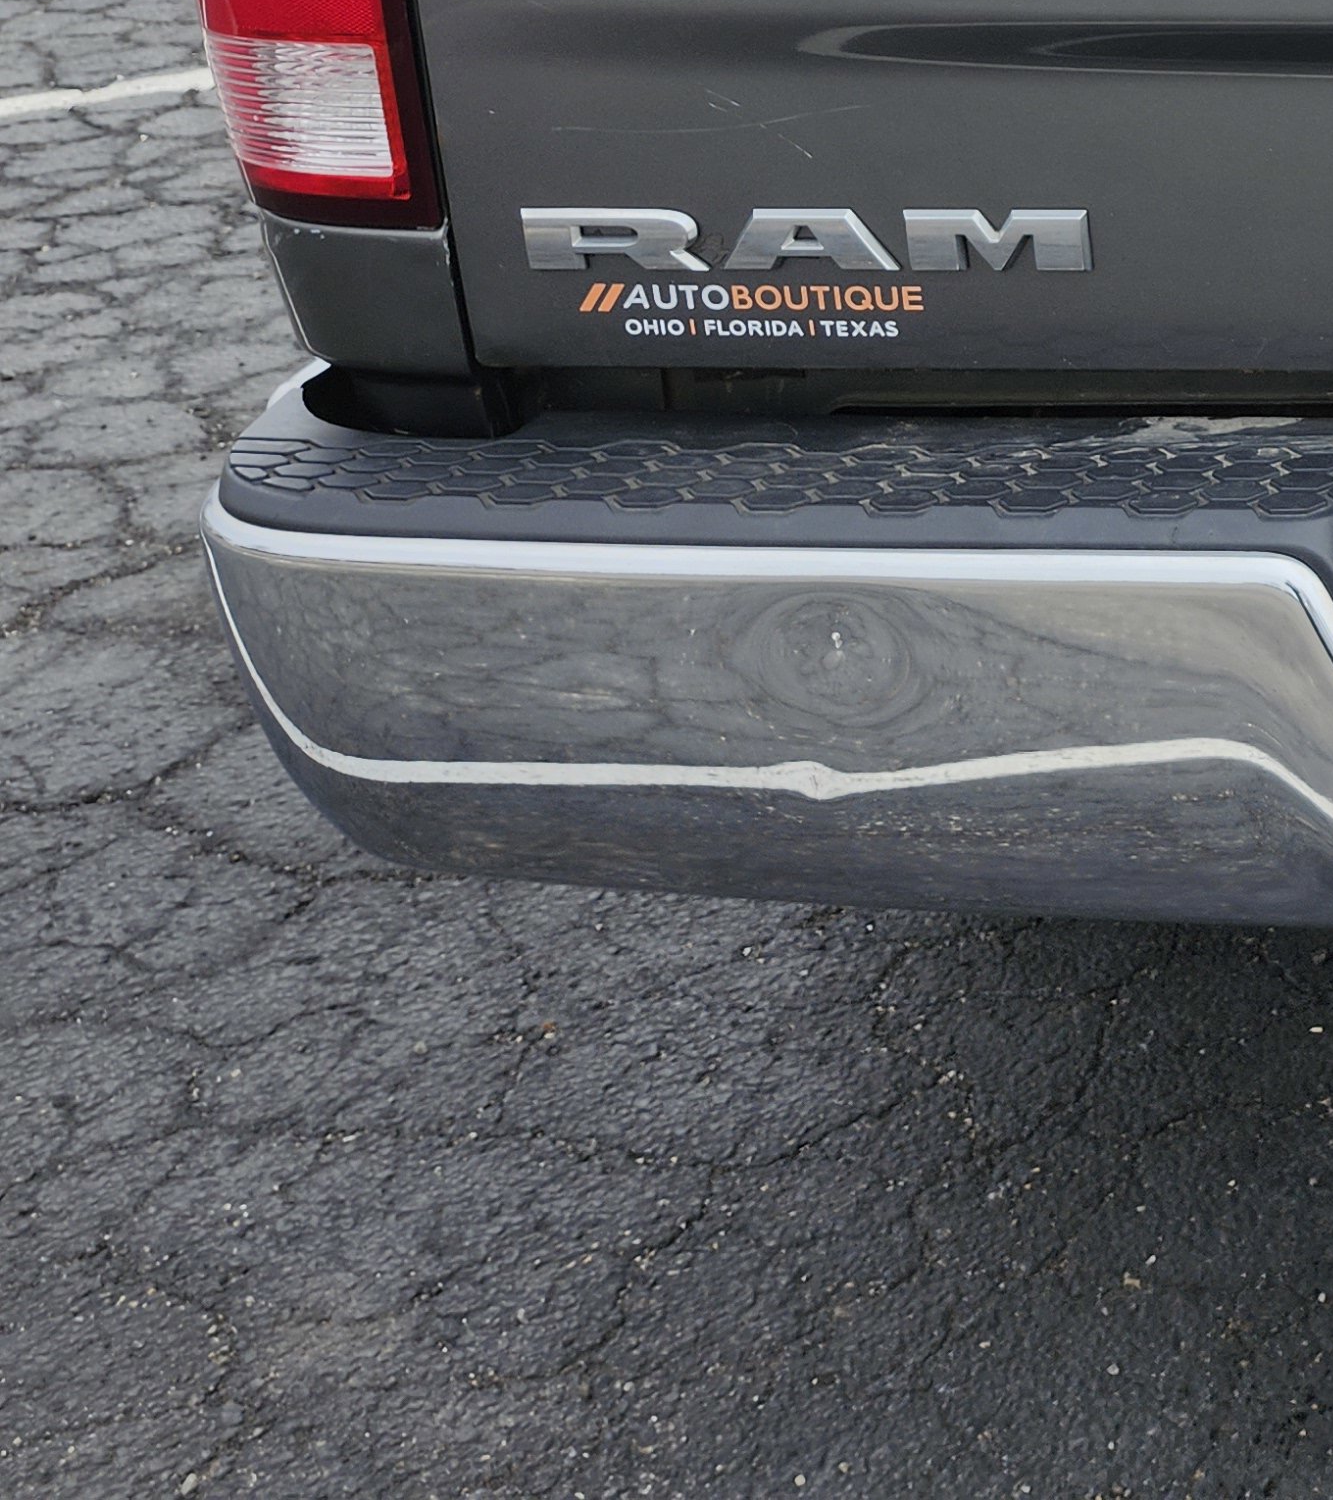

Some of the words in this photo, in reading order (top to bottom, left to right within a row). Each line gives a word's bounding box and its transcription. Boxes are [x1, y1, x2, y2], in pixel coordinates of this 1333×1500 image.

[520, 208, 1097, 271] RAM
[623, 283, 924, 311] AUTOBOUTIQUE
[625, 318, 685, 336] OHIO
[704, 319, 804, 337] FLORIDA
[819, 320, 899, 337] TEXAS
